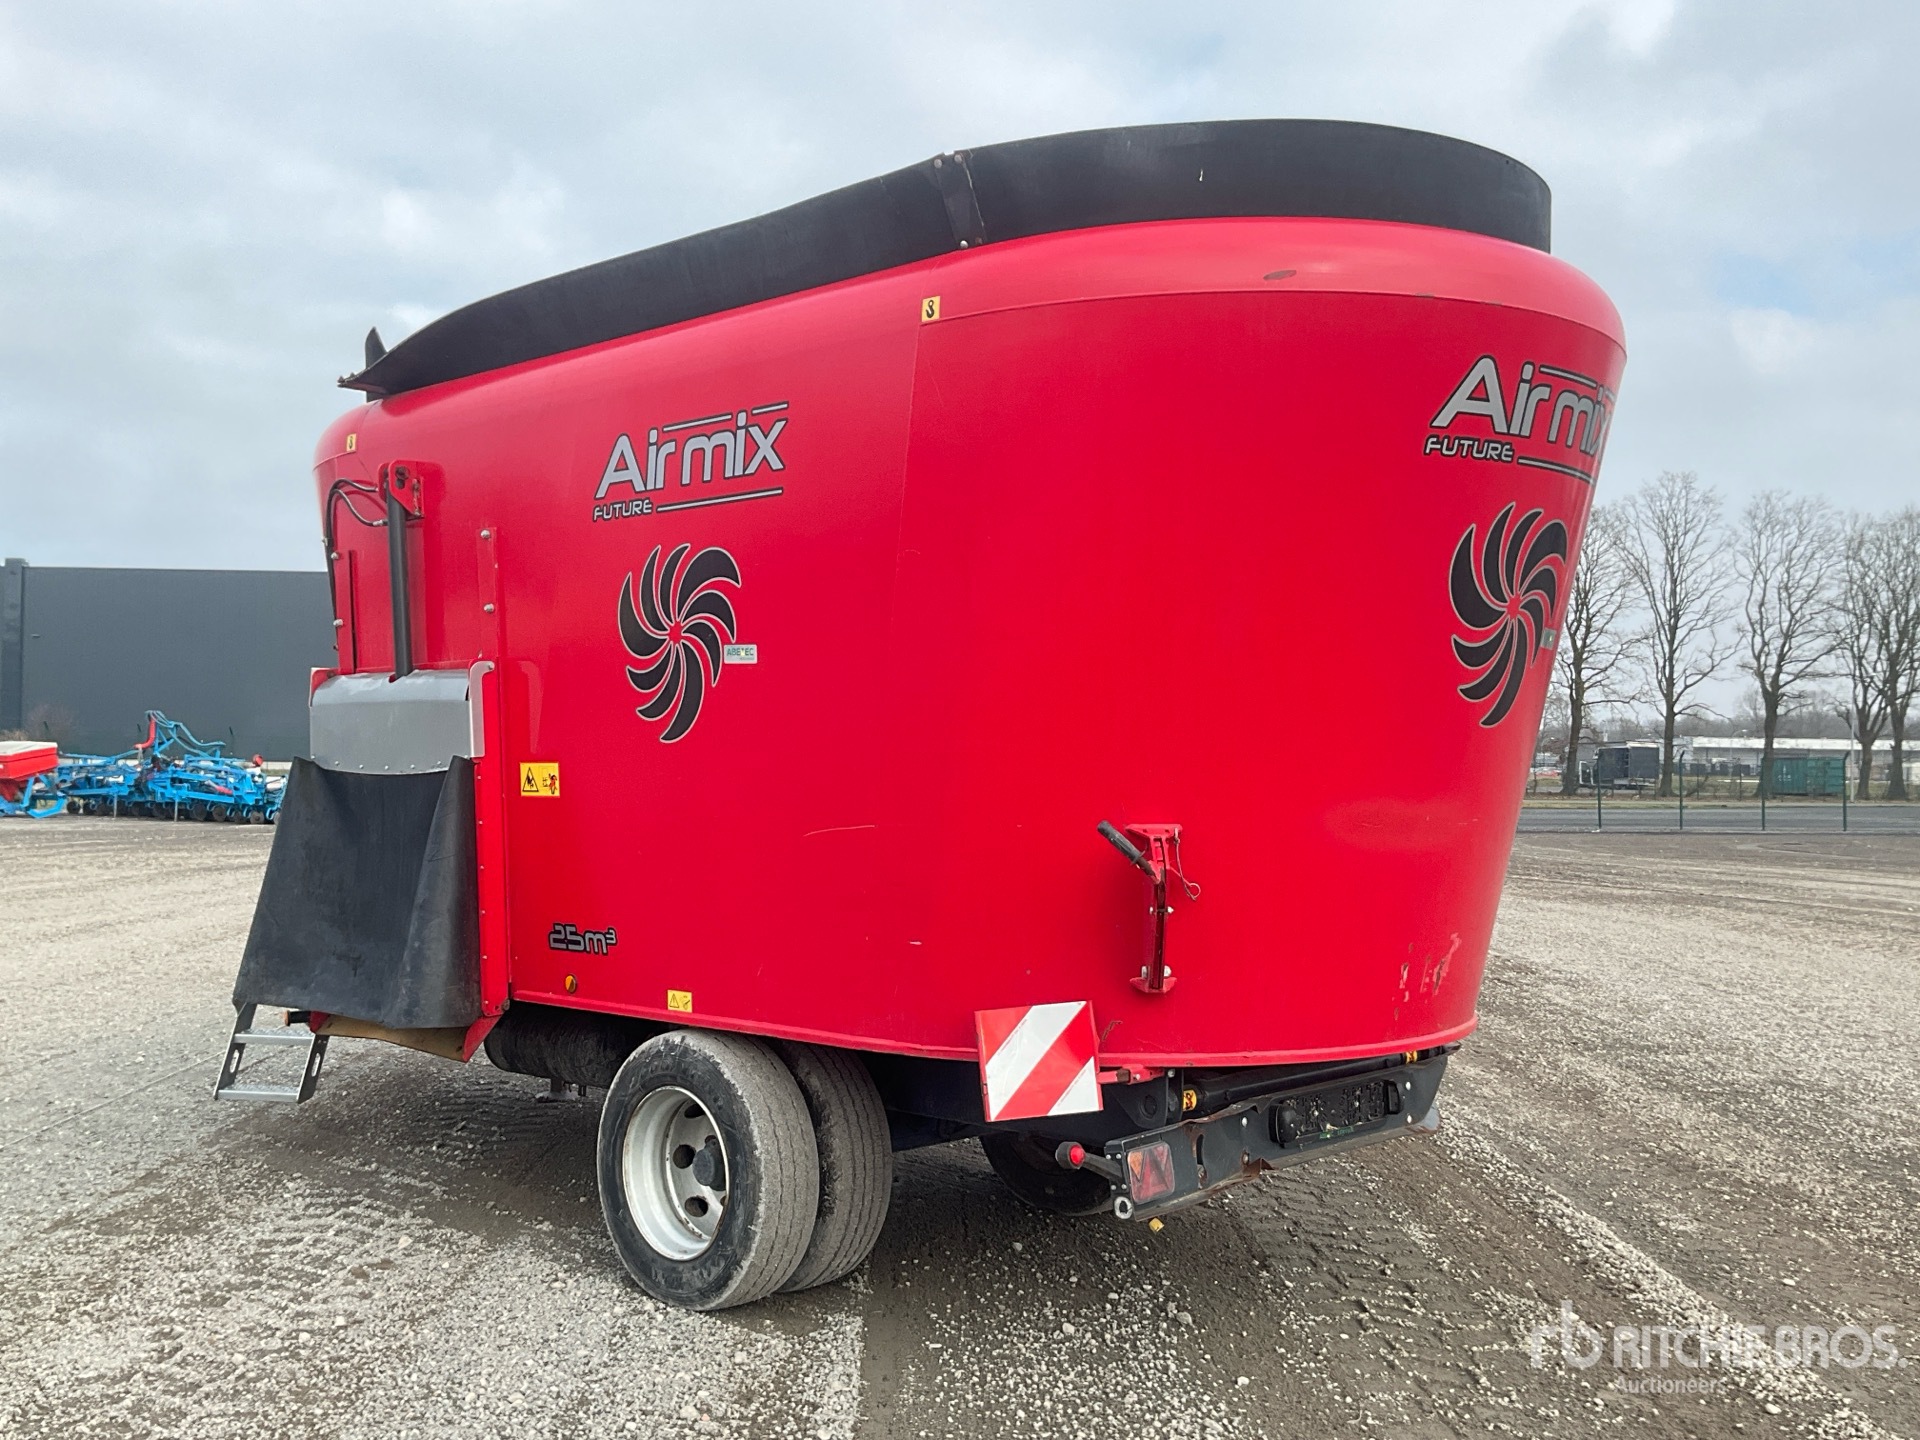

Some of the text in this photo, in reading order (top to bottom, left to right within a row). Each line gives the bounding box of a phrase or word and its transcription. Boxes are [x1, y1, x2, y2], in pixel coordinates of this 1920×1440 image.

[1429, 354, 1614, 456] Airmix
[594, 409, 788, 499] Airmix
[1424, 434, 1514, 463] FUTURE
[592, 498, 653, 522] FUTURE
